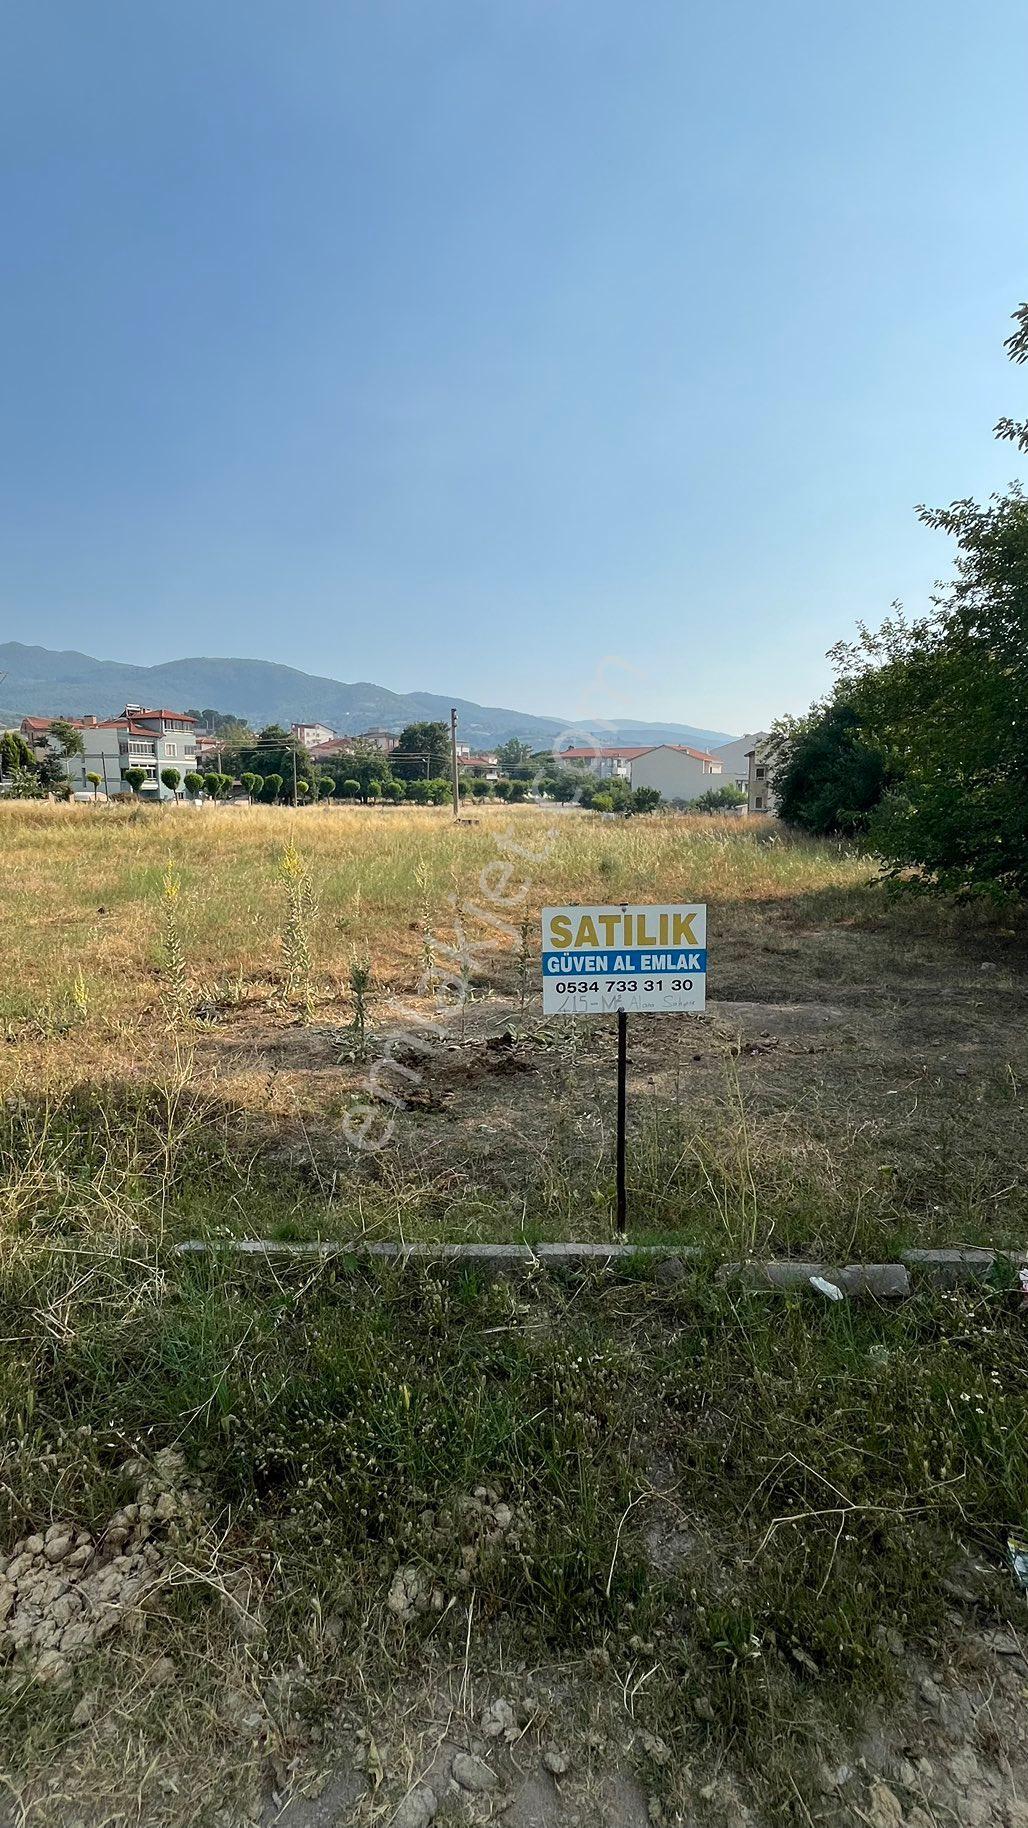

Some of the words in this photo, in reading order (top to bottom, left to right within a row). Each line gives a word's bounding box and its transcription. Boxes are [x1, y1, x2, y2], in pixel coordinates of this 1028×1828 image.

[547, 952, 608, 973] GÜVEN
[613, 955, 635, 971] AL
[641, 954, 701, 971] EMLAK
[555, 981, 599, 994] 0534
[605, 980, 637, 992] 733
[643, 979, 663, 992] 31
[671, 979, 693, 991] 30
